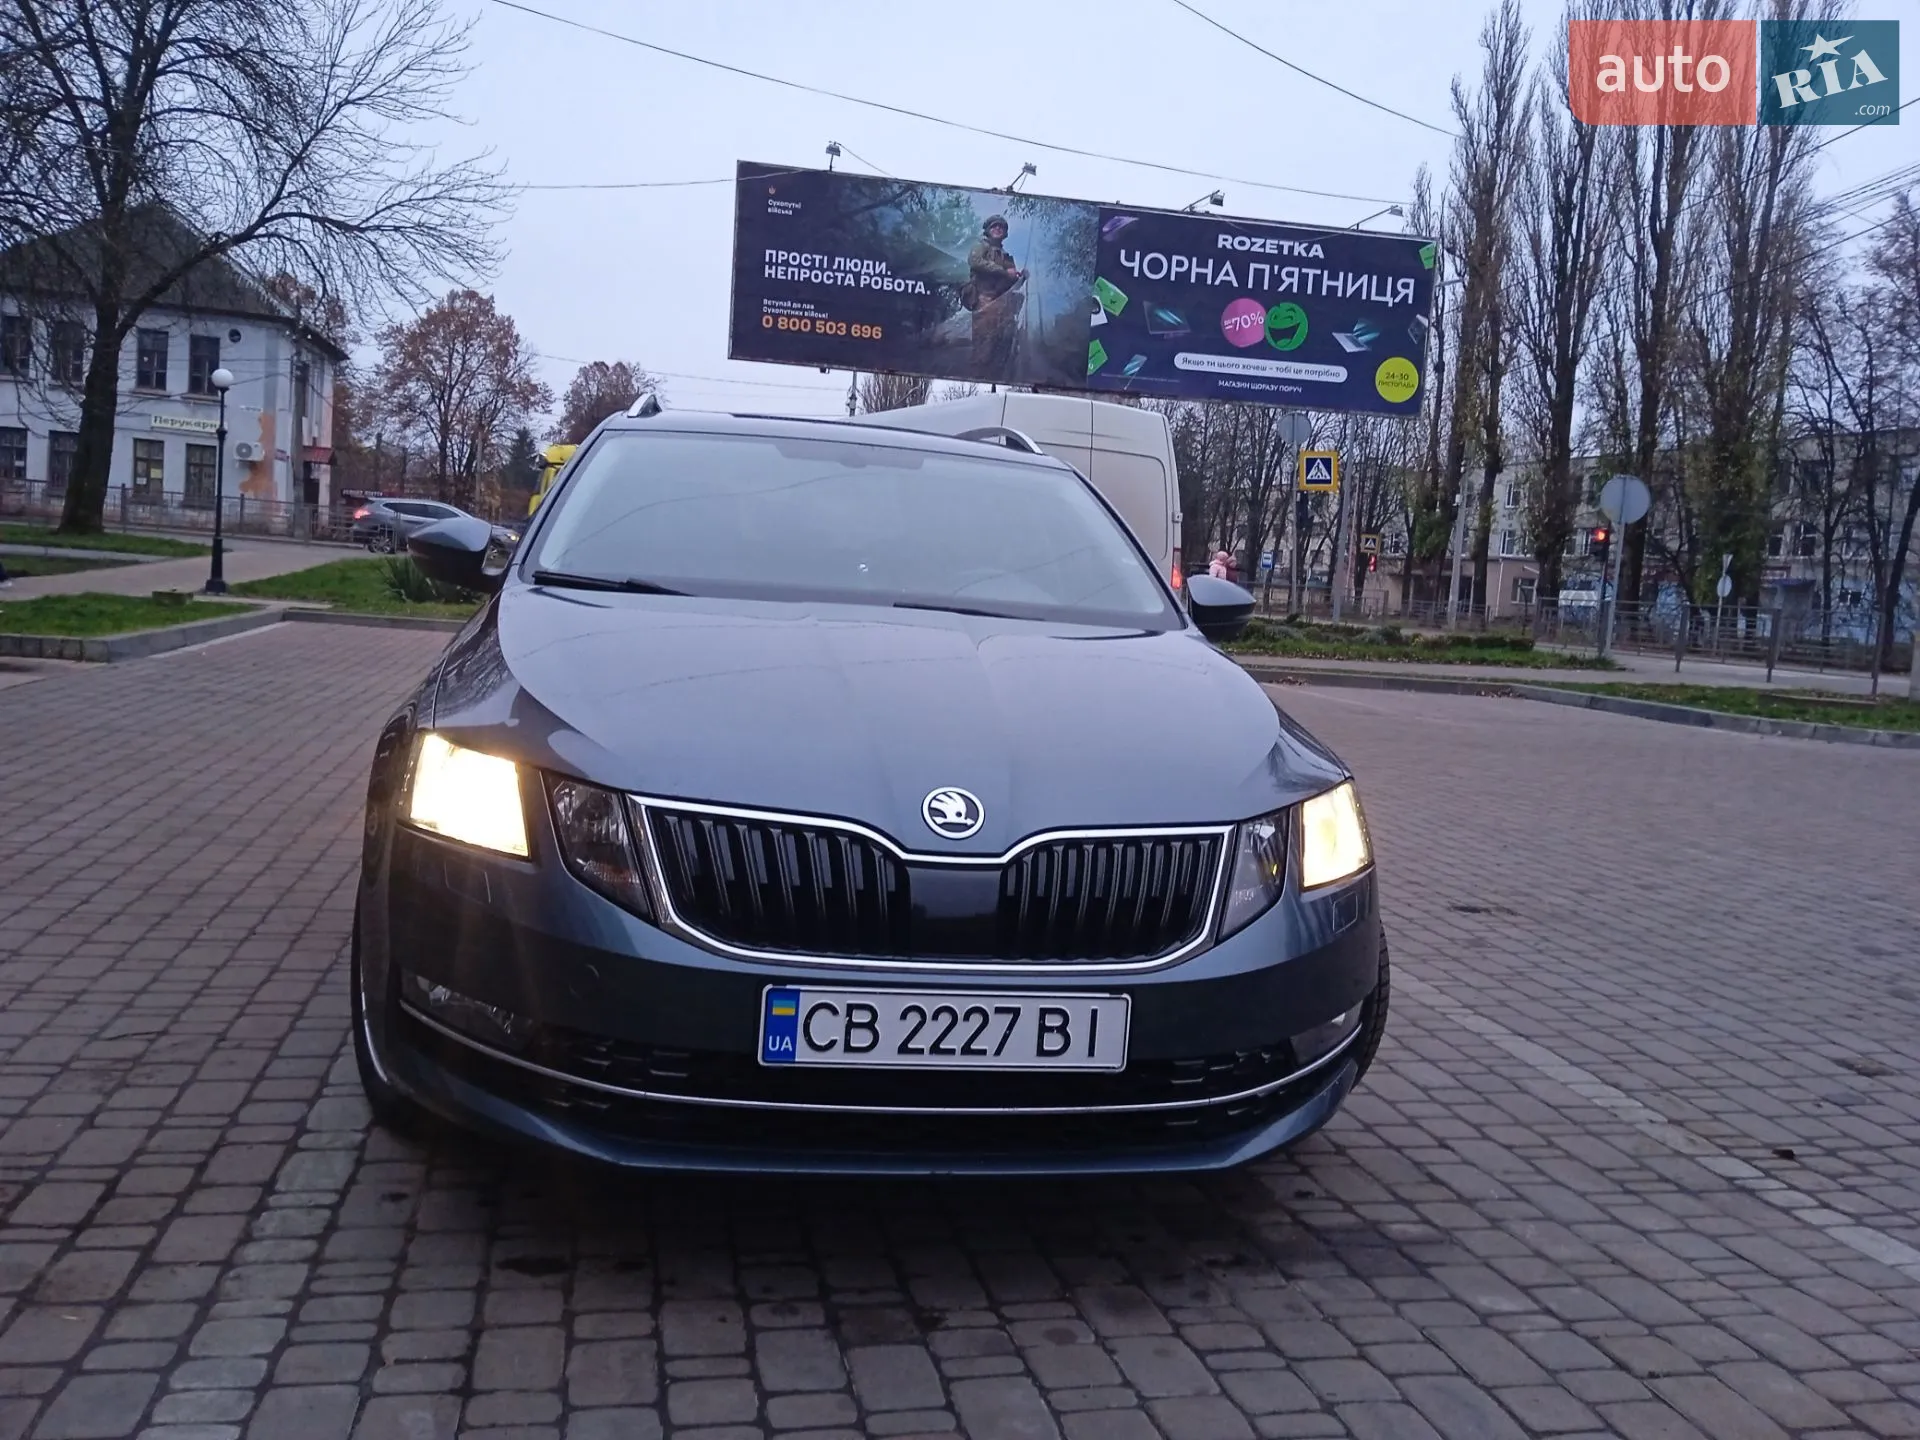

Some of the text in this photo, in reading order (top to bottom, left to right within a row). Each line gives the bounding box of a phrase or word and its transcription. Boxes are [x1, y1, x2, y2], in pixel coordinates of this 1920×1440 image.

[1217, 234, 1325, 260] ROZETKA
[765, 249, 892, 276] ПРОСТІ ЛЮДИ.
[764, 264, 931, 296] НЕПРОСТА РОБОТА.
[1119, 249, 1416, 308] ЧОРНА П'ЯТНИЦЯ
[762, 315, 882, 339] 0 800 503 696
[1181, 357, 1205, 368] Якщо
[1217, 362, 1240, 371] цього
[1241, 364, 1267, 372] хочеш
[1275, 365, 1292, 374] тобі
[1293, 367, 1303, 376] це
[1304, 368, 1341, 379] потрібно
[153, 415, 218, 430] Перукарн
[802, 1001, 880, 1054] CB
[897, 1003, 1022, 1057] 2227
[768, 1035, 793, 1052] UA
